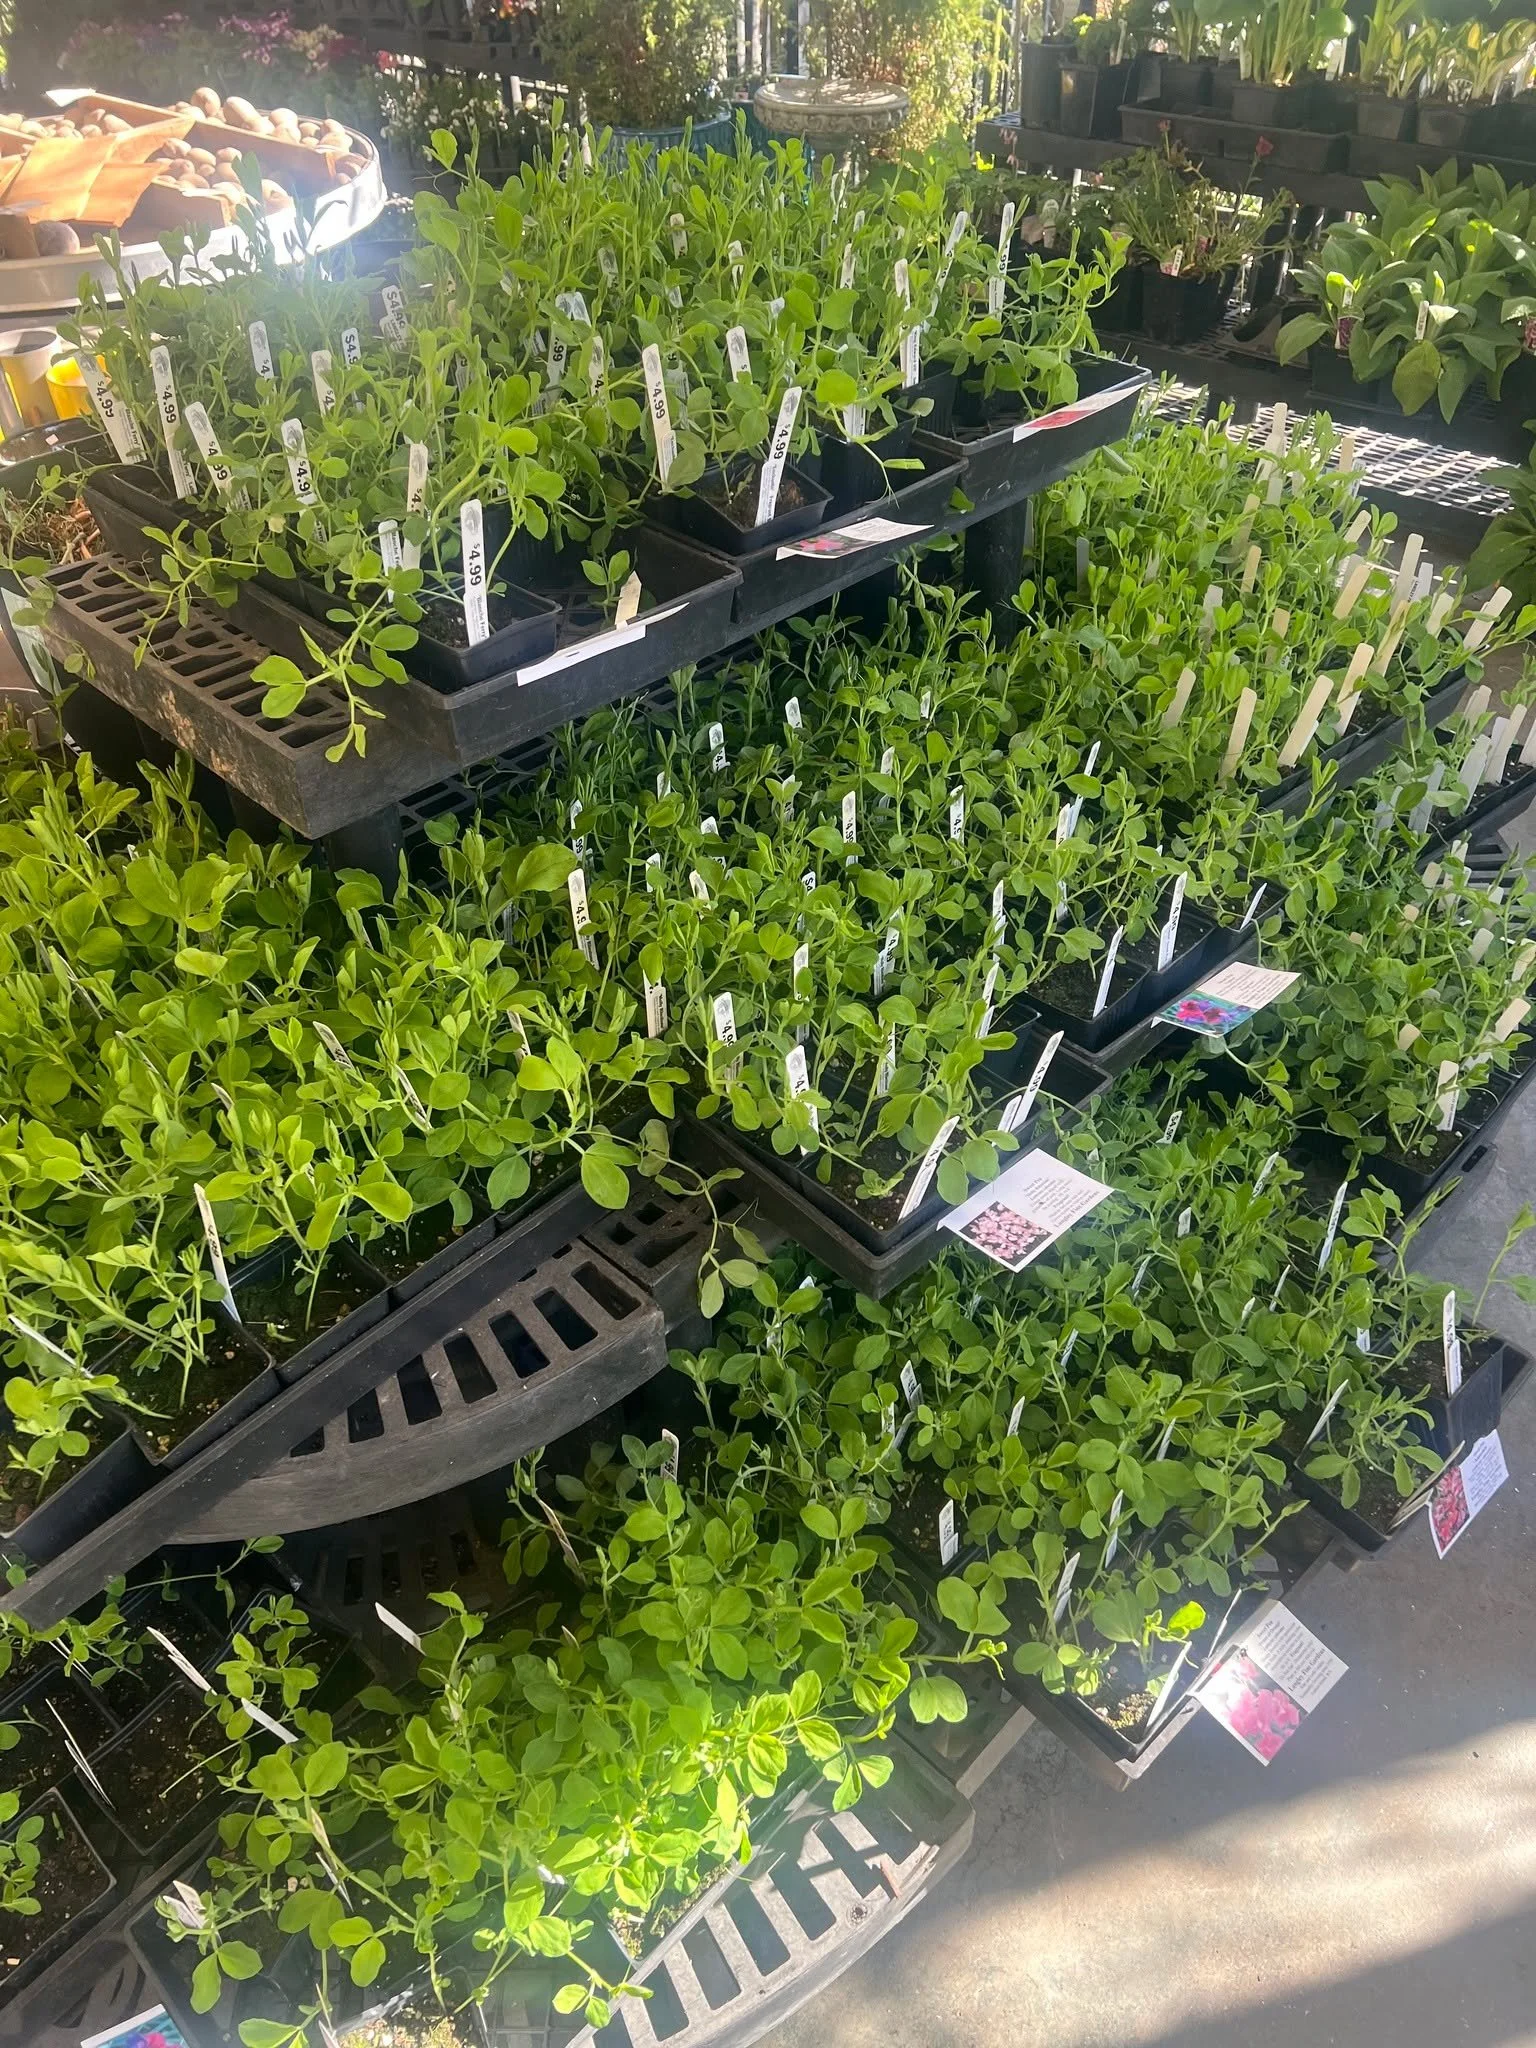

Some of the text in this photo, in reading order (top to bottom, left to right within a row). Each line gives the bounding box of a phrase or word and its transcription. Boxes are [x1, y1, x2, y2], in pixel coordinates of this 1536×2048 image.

[162, 384, 177, 424] $4.99
[652, 380, 665, 419] $4.99
[773, 423, 791, 460] $4.99
[296, 460, 313, 498] $4.9
[469, 543, 482, 587] $4.99
[1288, 1674, 1304, 1691] Langley
[1301, 1664, 1311, 1674] Fine
[1309, 1648, 1326, 1665] Gardens
